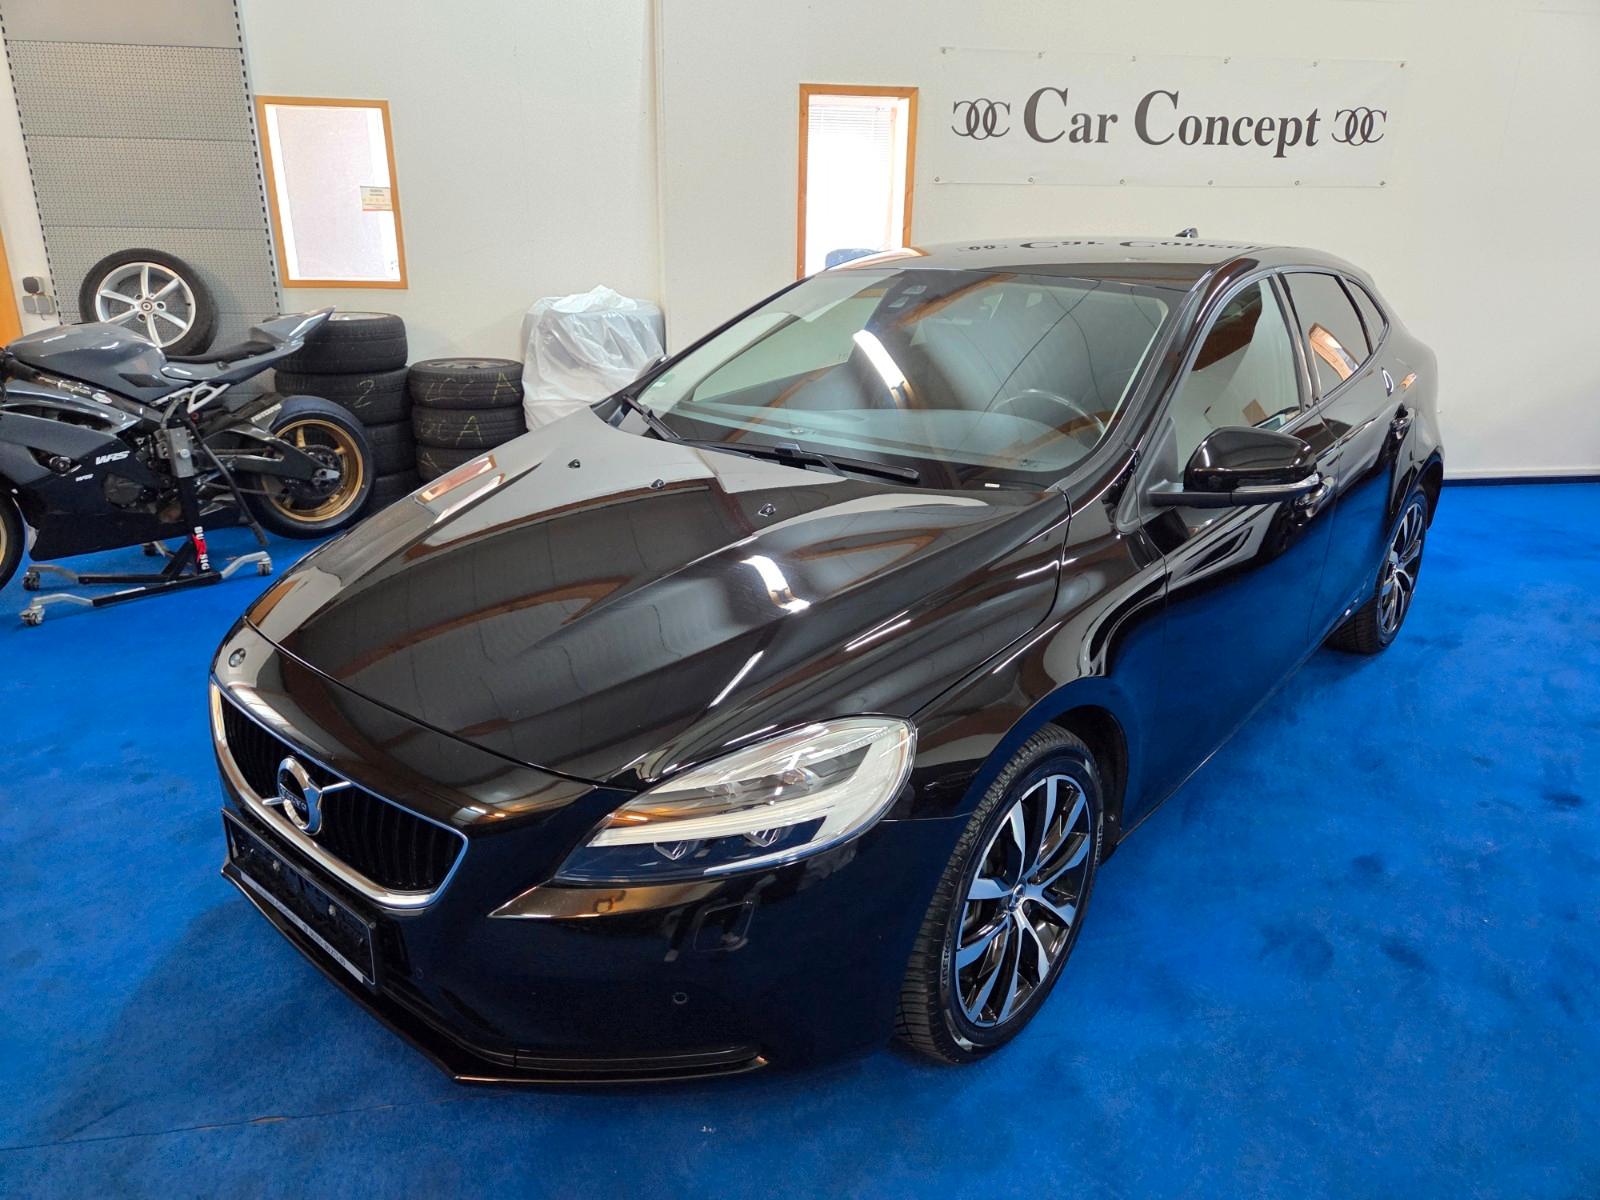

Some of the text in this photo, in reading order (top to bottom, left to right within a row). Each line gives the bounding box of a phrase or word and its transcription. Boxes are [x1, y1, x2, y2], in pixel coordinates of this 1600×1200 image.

[1023, 86, 1119, 144] Car
[1134, 89, 1321, 158] Concept
[353, 379, 375, 409] 2
